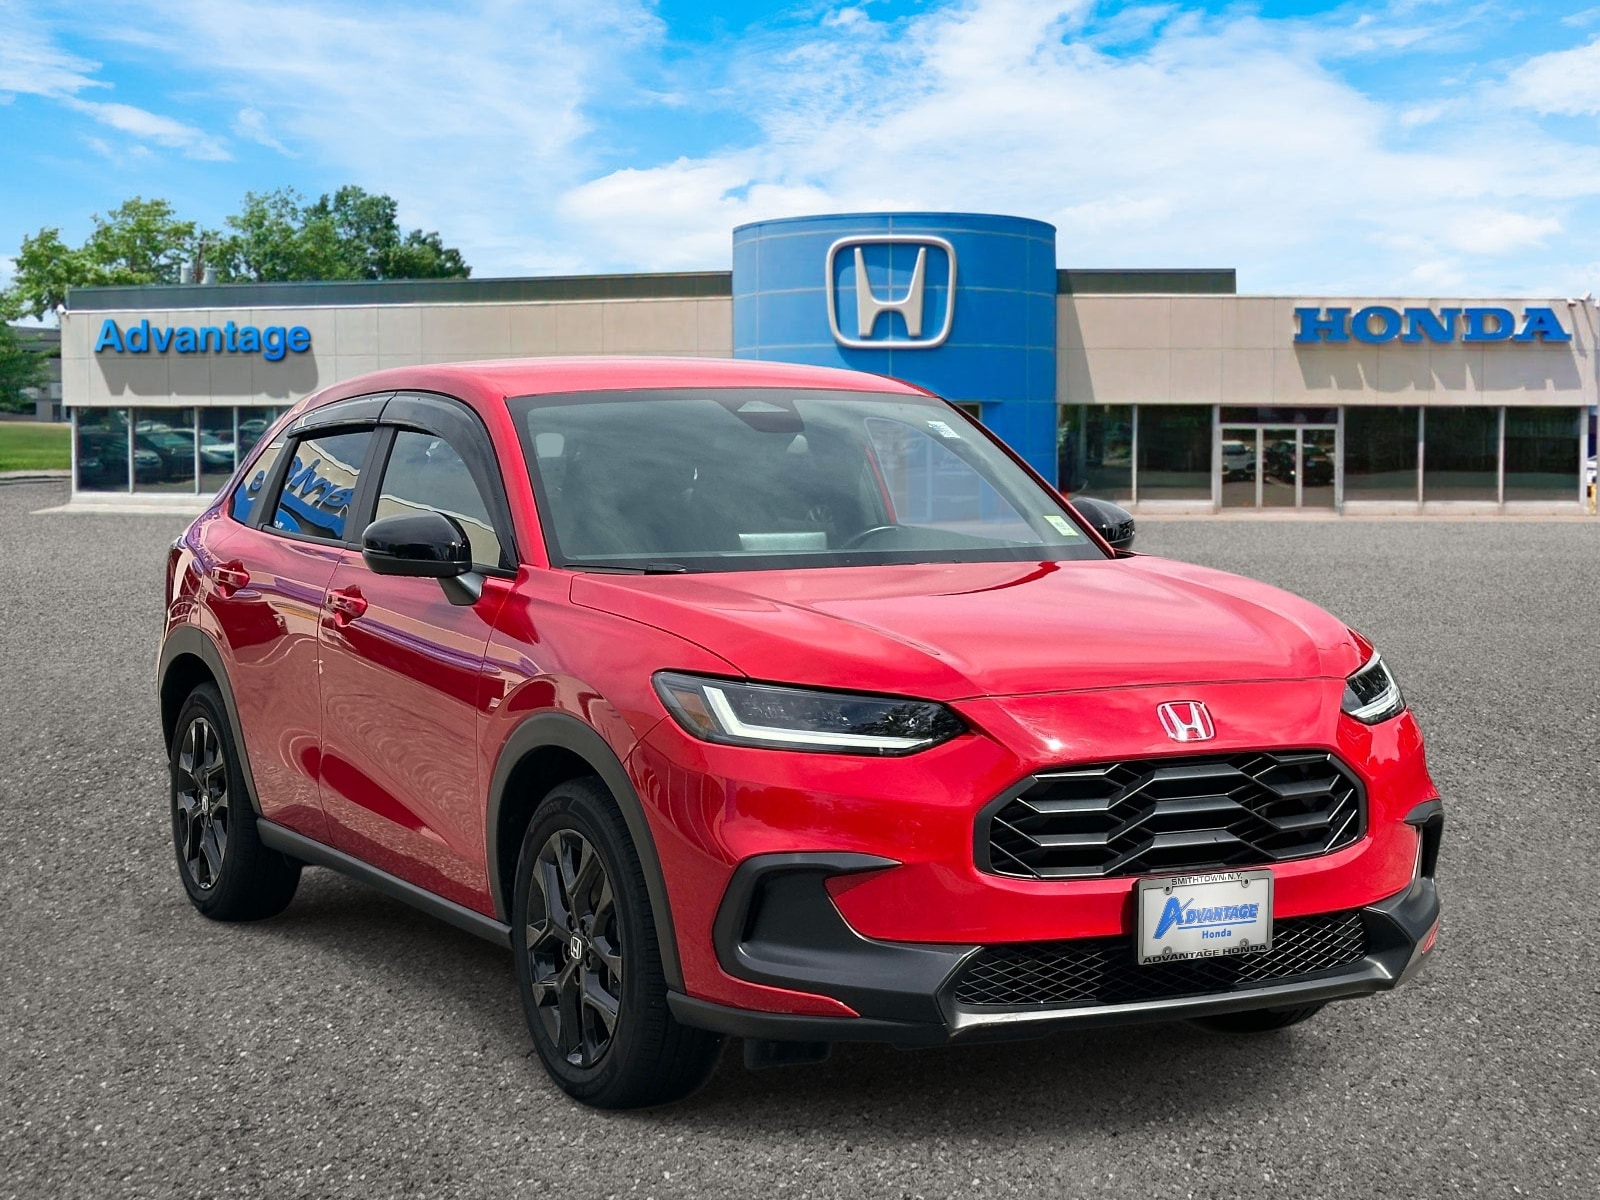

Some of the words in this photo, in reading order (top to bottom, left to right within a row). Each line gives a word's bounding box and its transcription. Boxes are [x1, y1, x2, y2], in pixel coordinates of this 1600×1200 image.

[1293, 305, 1573, 344] HONDA
[94, 318, 312, 362] Advantage
[1201, 928, 1232, 939] Honda
[1143, 949, 1220, 964] ADVANTAGE
[1222, 944, 1268, 956] HONDA
